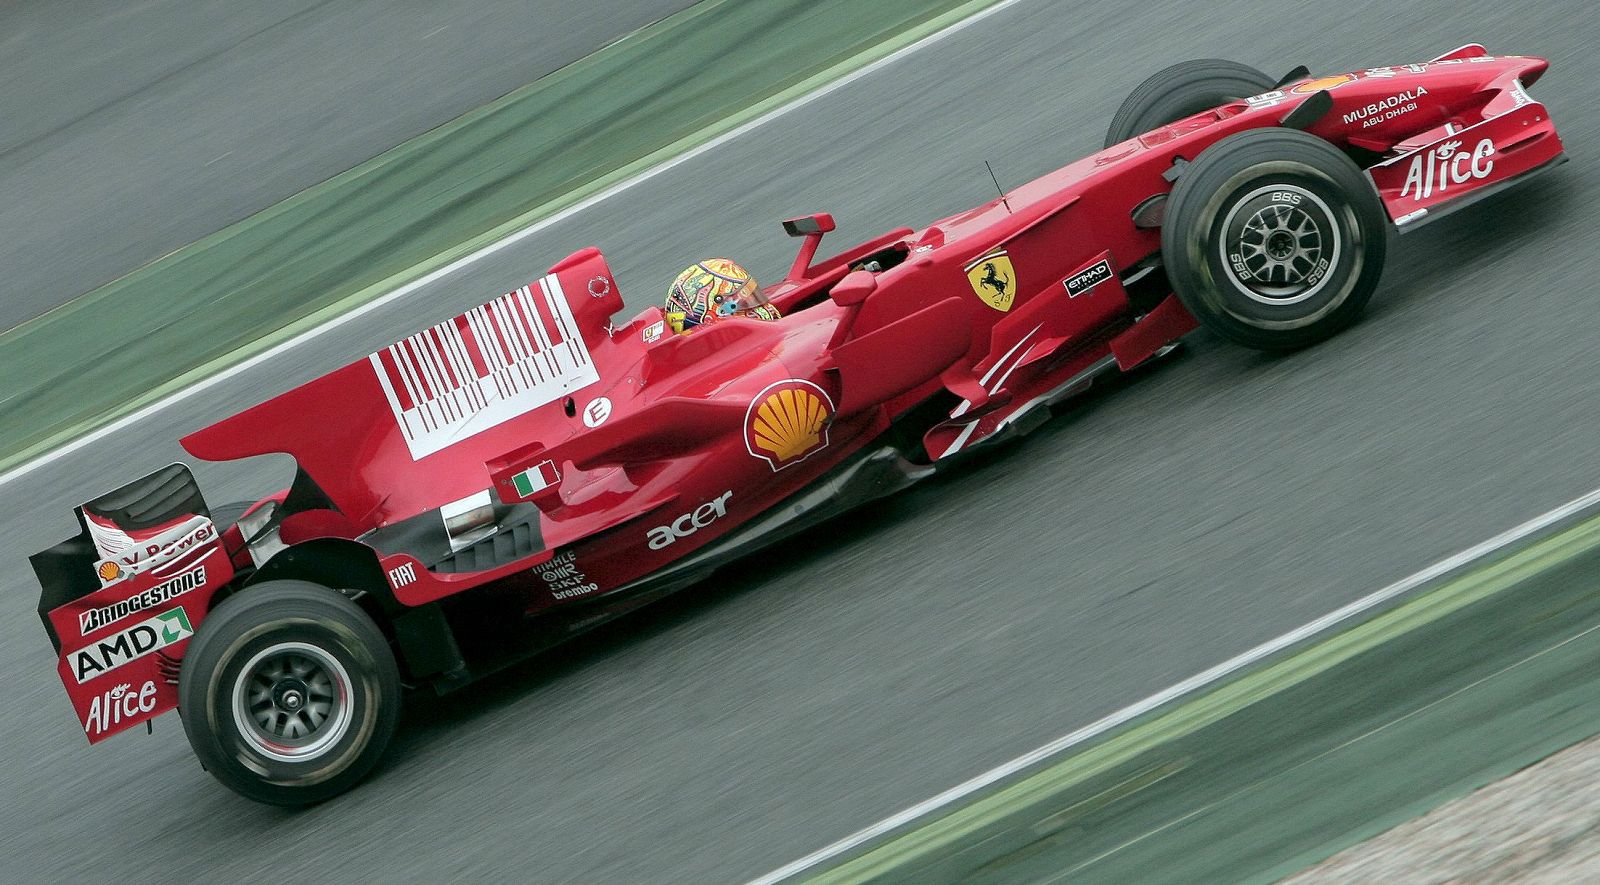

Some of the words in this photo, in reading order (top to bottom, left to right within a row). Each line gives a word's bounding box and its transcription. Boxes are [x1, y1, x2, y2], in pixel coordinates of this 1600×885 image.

[1343, 86, 1428, 124] MUBADALA
[1363, 115, 1385, 129] ABU
[1385, 102, 1418, 119] DHABI
[1400, 138, 1495, 201] Alice
[1271, 192, 1302, 205] BBS
[1068, 265, 1107, 289] ETIHAD
[1230, 252, 1252, 281] BBS
[1307, 257, 1329, 286] BBS
[589, 400, 607, 423] E
[646, 490, 734, 550] acer
[388, 561, 418, 590] FIAT
[549, 573, 585, 590] SKF
[81, 567, 206, 635] BRIDGESTONE
[552, 582, 599, 600] brembo
[77, 625, 158, 681] AMD
[86, 680, 157, 733] Alice
